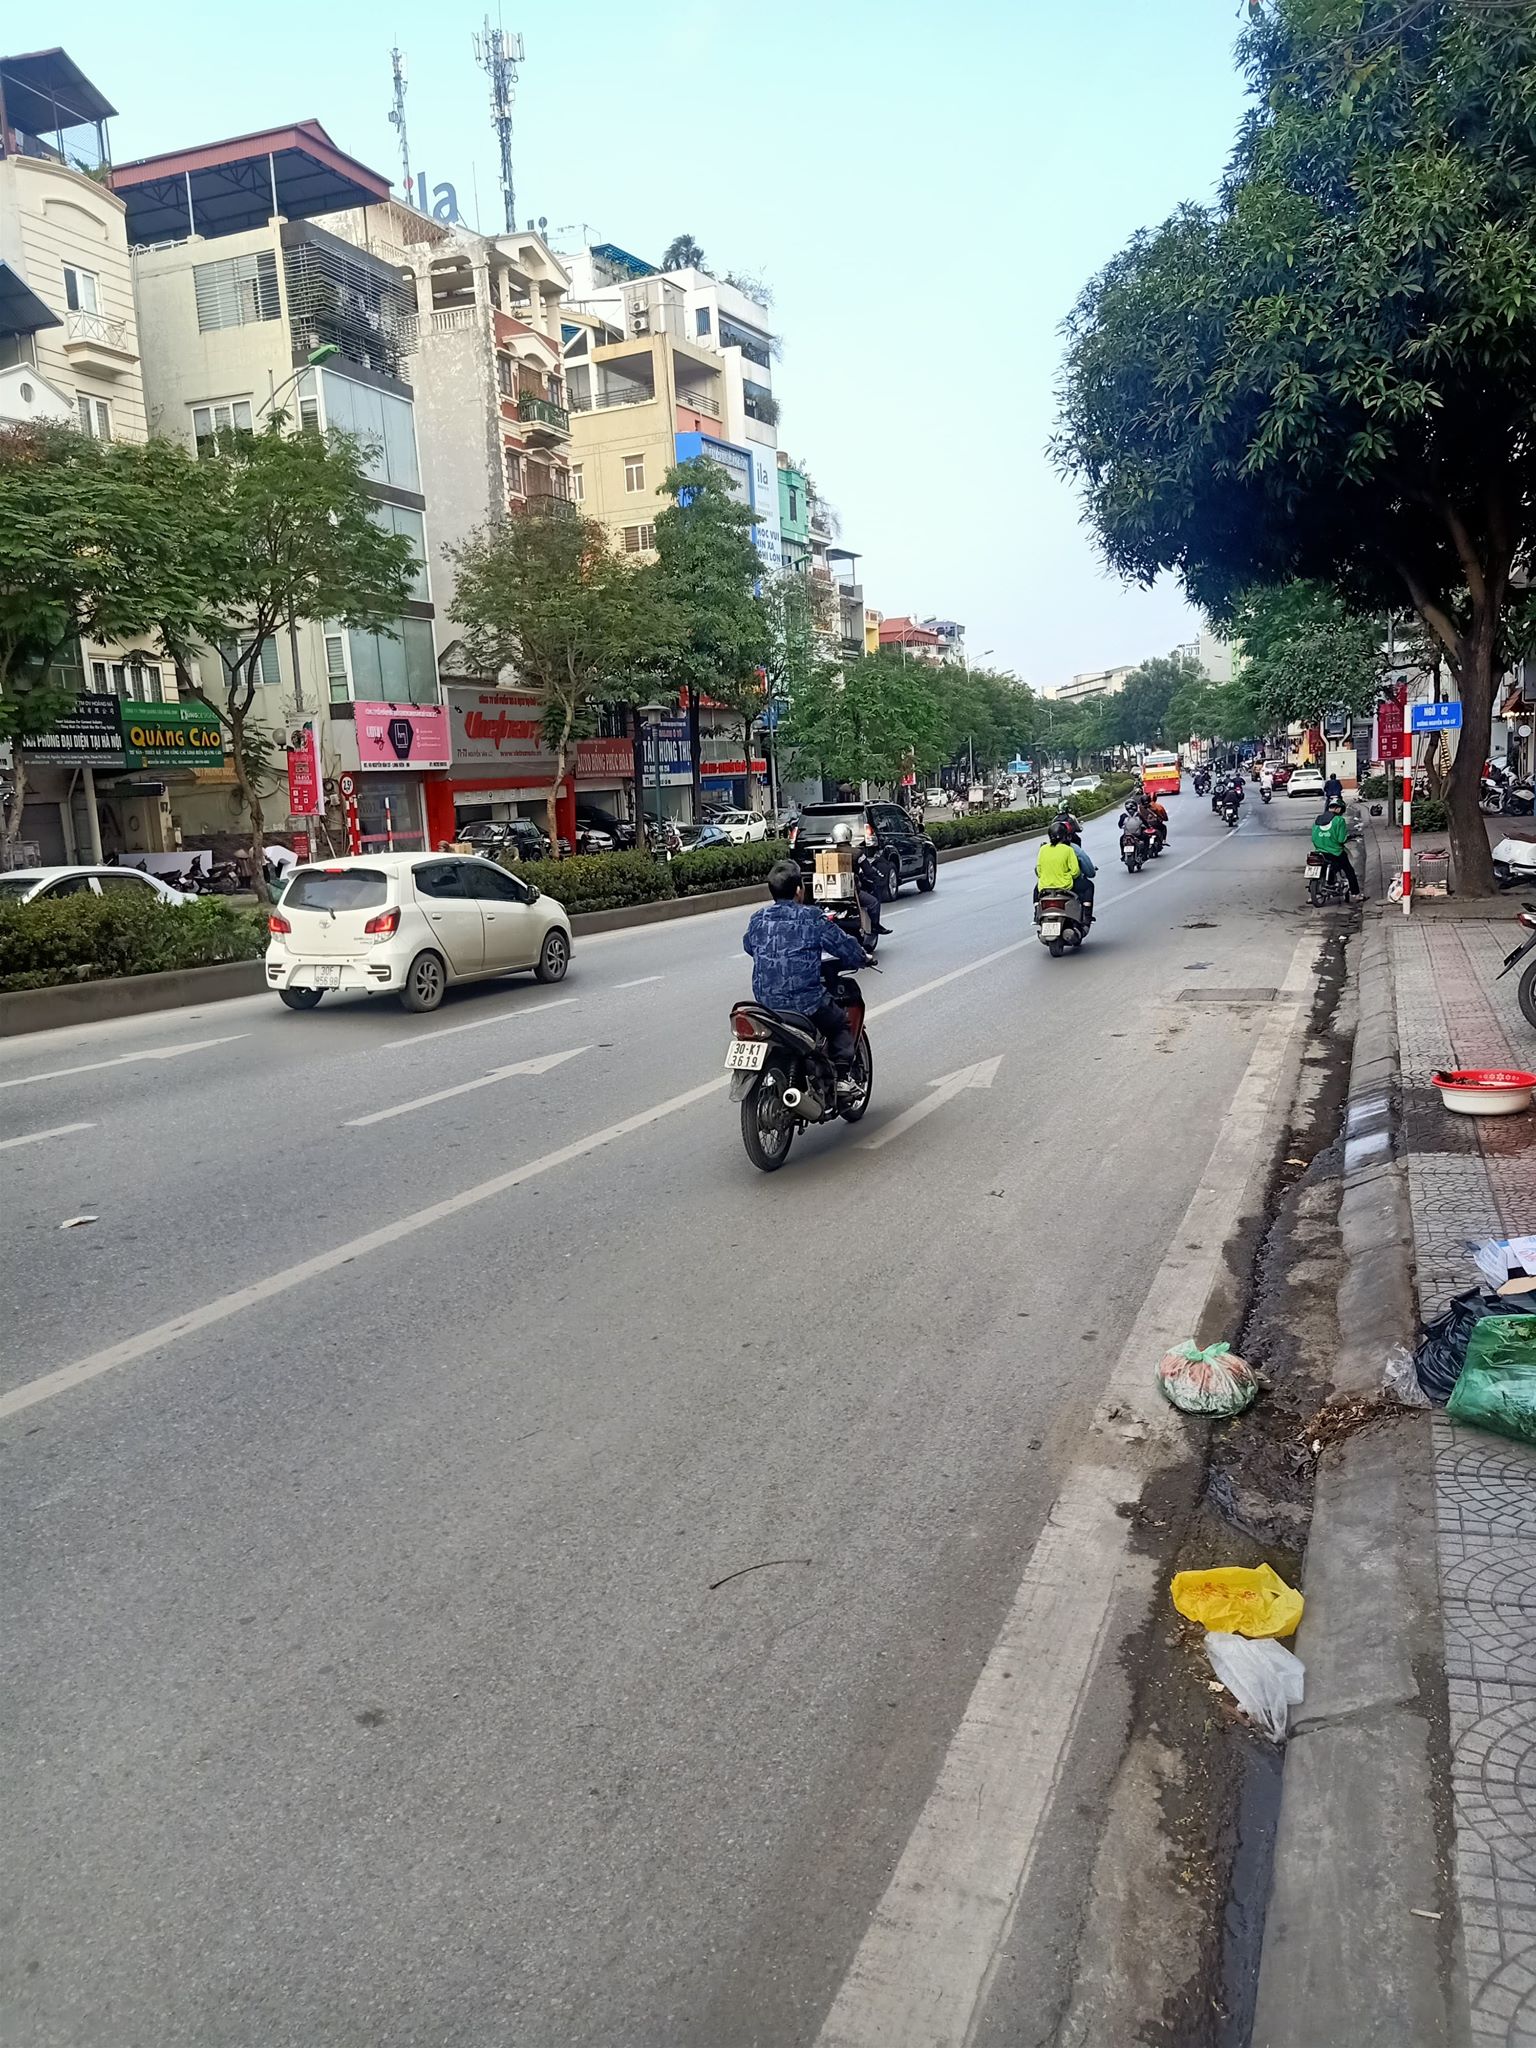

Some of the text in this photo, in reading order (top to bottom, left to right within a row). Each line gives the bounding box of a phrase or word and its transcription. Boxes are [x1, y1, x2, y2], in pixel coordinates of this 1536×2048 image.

[757, 462, 768, 485] ila
[1424, 705, 1436, 716] NGÕ
[60, 734, 73, 750] ĐẠI
[73, 732, 89, 750] DIỆN
[89, 735, 101, 750] TẠI
[101, 732, 110, 748] HÀ
[110, 733, 122, 750] NỘI
[189, 726, 221, 747] CÁO
[734, 1043, 760, 1055] 30-K1
[731, 1055, 758, 1067] 3619
